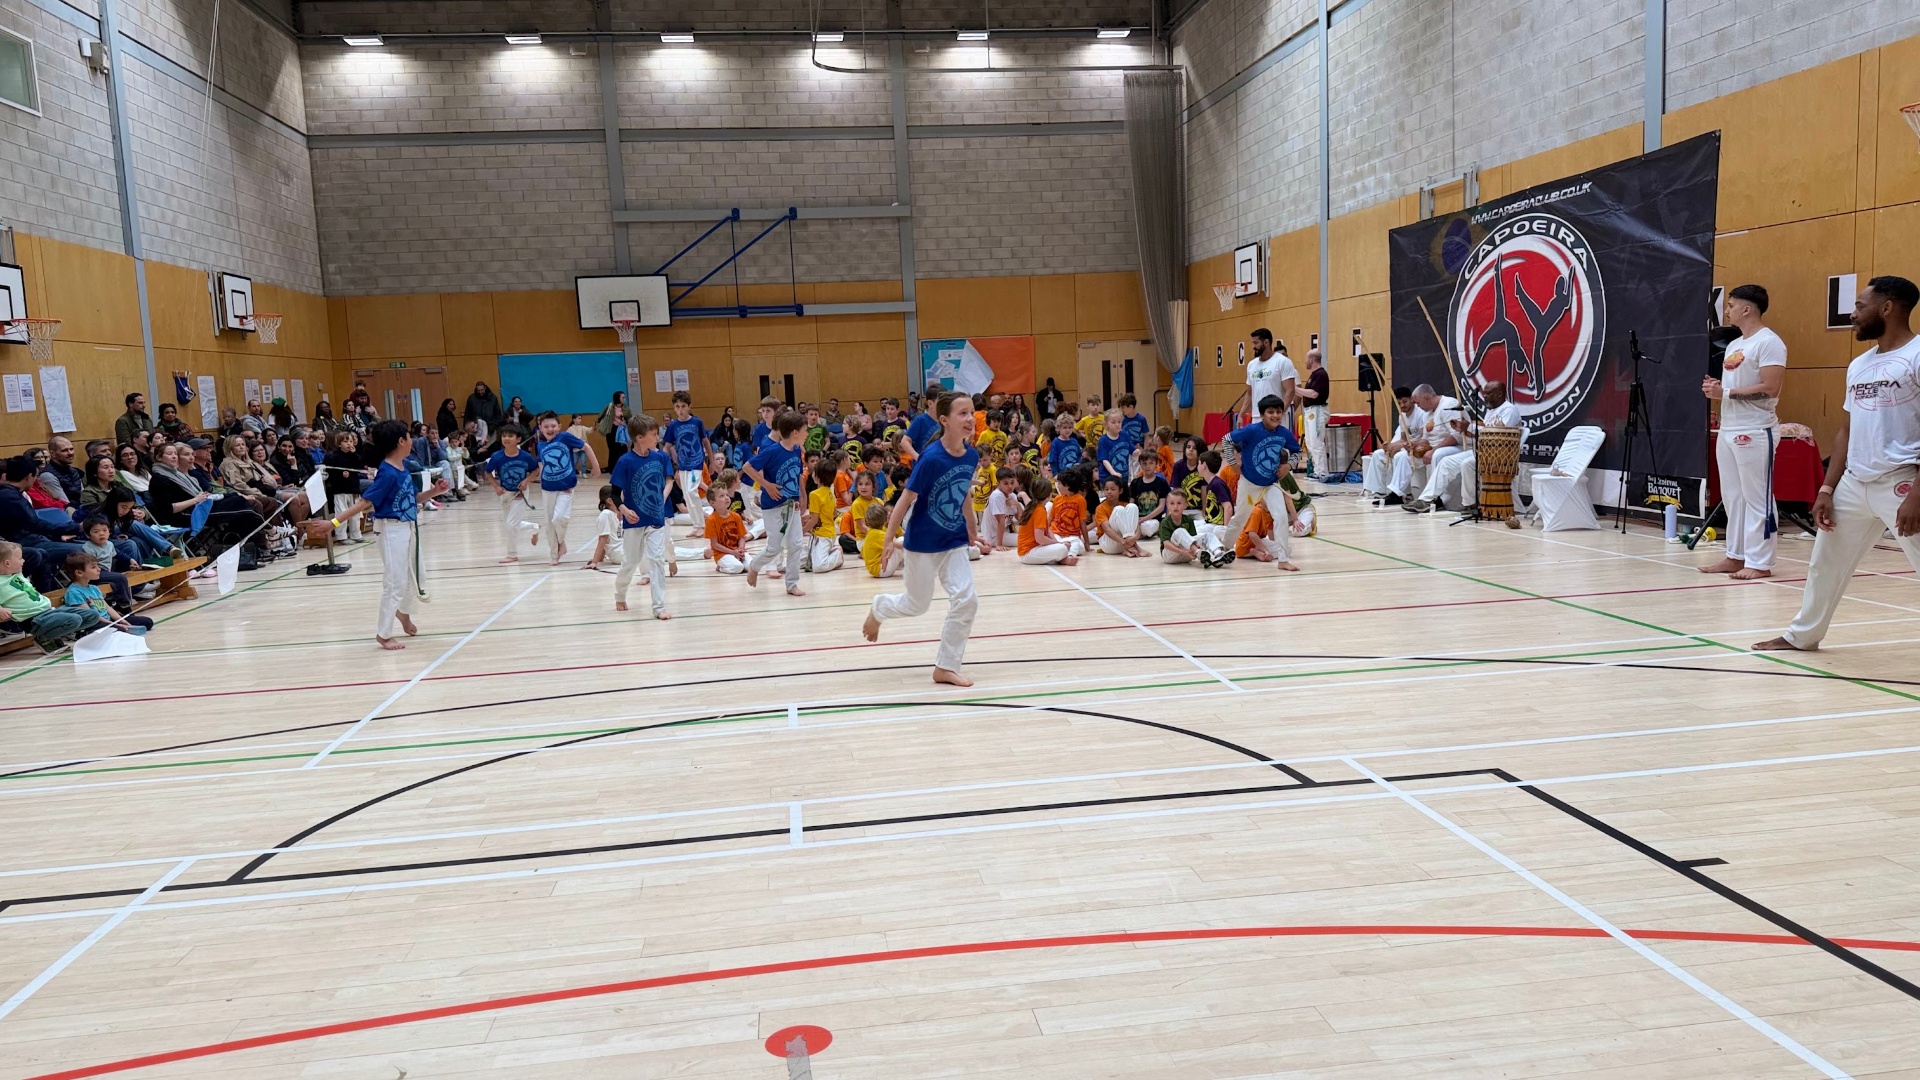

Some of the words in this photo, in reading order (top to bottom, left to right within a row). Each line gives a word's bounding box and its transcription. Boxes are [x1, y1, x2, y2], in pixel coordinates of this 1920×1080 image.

[1464, 219, 1587, 279] CAPOEIRA
[1829, 276, 1853, 327] L
[1194, 347, 1199, 367] A
[1217, 346, 1223, 367] B
[1239, 342, 1244, 364] C
[1520, 385, 1581, 428] NDON
